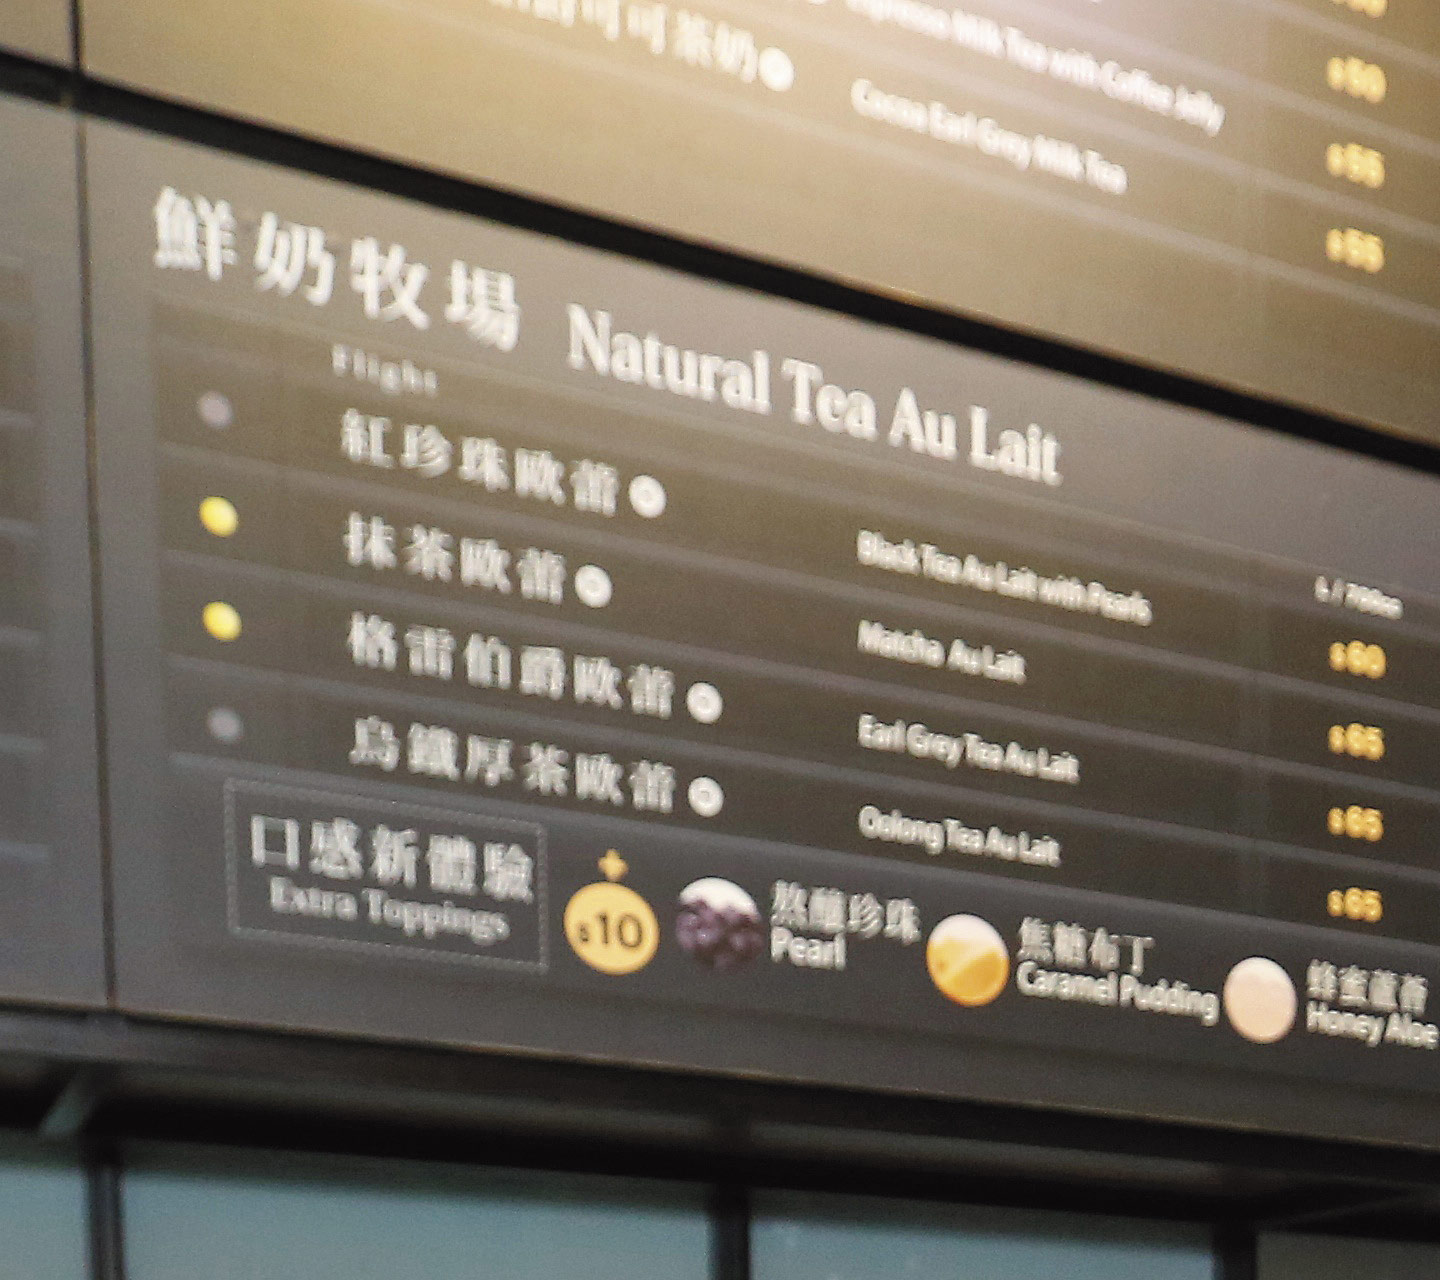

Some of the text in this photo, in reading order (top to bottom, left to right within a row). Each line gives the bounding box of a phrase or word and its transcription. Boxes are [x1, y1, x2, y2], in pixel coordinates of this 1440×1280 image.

[951, 7, 1005, 57] Milk
[1005, 26, 1049, 73] Tea
[1100, 60, 1176, 114] Coffee
[1175, 85, 1226, 138] Jelly
[926, 103, 978, 142] Earl
[976, 119, 1033, 166] Grey
[1030, 136, 1082, 178] Milk
[1082, 151, 1125, 192] Tea
[153, 185, 524, 353] 鮮奶牧場
[570, 305, 1057, 482] Natural Tea Au Lait
[858, 532, 1150, 622] Black Tea Au Lait with Pearls
[859, 622, 1024, 680] Matcha Au Lait
[859, 715, 1077, 780] Earl Grey Tea Au Lait
[859, 807, 1058, 864] Oolong Tea Au Lait
[268, 875, 511, 946] Extra Toppings
[769, 926, 848, 971] Pearl
[1015, 959, 1221, 1028] Caramel Pudding
[1305, 1000, 1384, 1048] Honey
